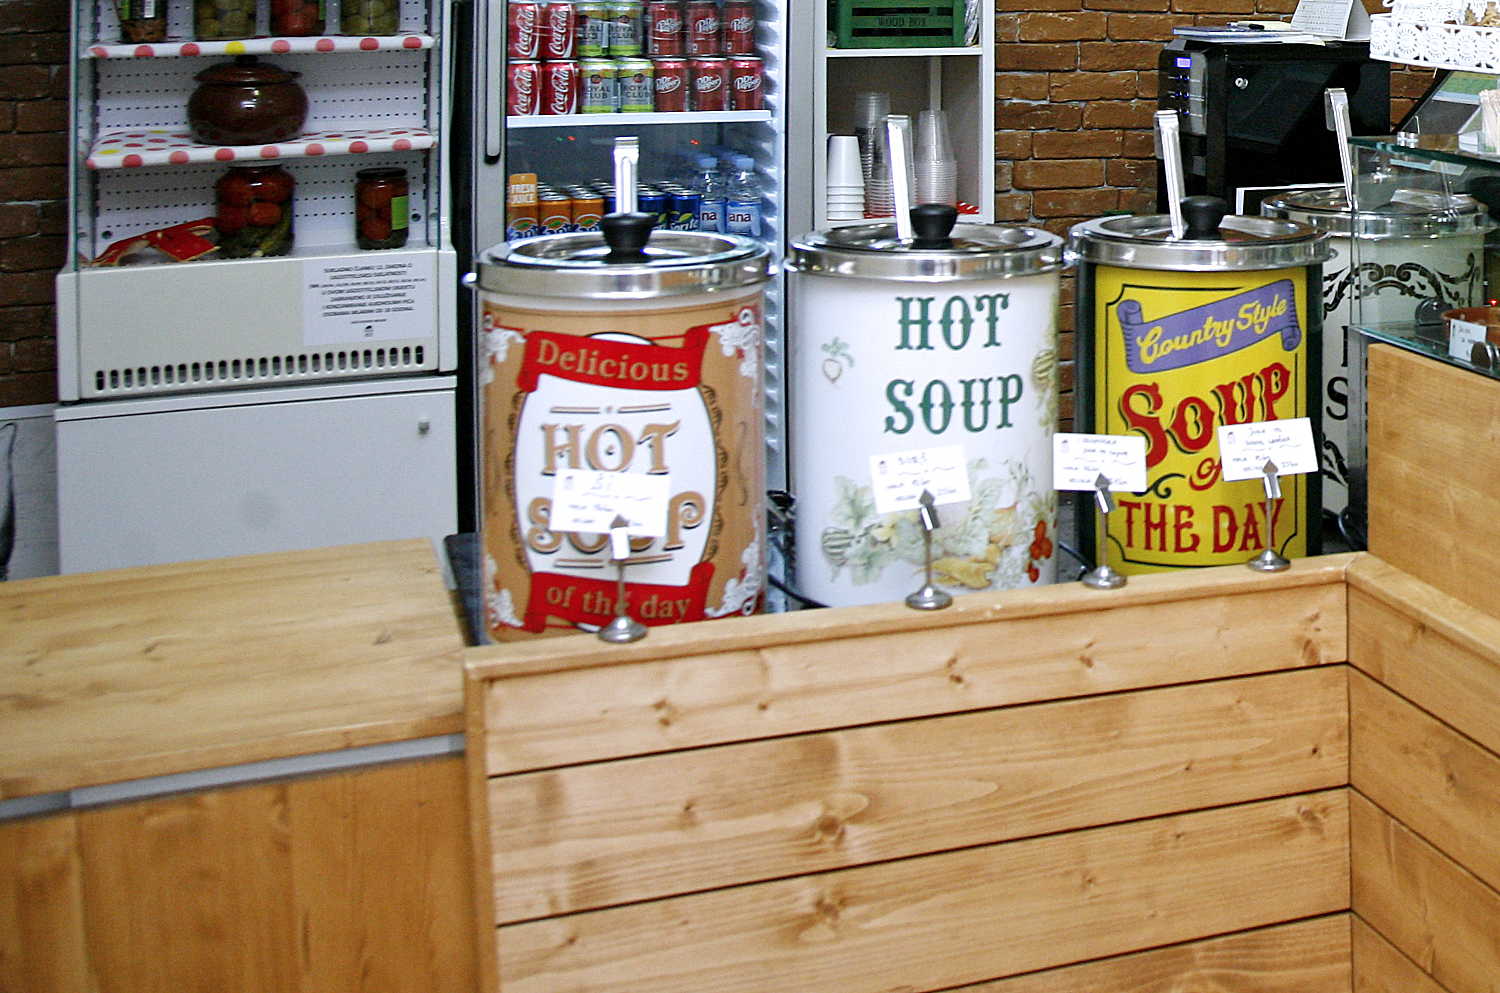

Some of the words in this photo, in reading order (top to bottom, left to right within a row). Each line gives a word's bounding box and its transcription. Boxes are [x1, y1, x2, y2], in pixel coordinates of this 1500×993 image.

[511, 184, 535, 195] FRESH
[511, 194, 535, 205] JUICE
[895, 293, 1010, 350] HOT
[1136, 316, 1237, 365] Country
[1236, 295, 1288, 333] Style
[537, 340, 689, 383] Delicious
[883, 374, 1023, 435] SOUP
[1119, 362, 1290, 469] SOUP
[540, 419, 681, 477] HOT
[1119, 499, 1200, 553] THE
[1212, 498, 1285, 554] DAY
[546, 585, 577, 607] of
[640, 594, 692, 624] day
